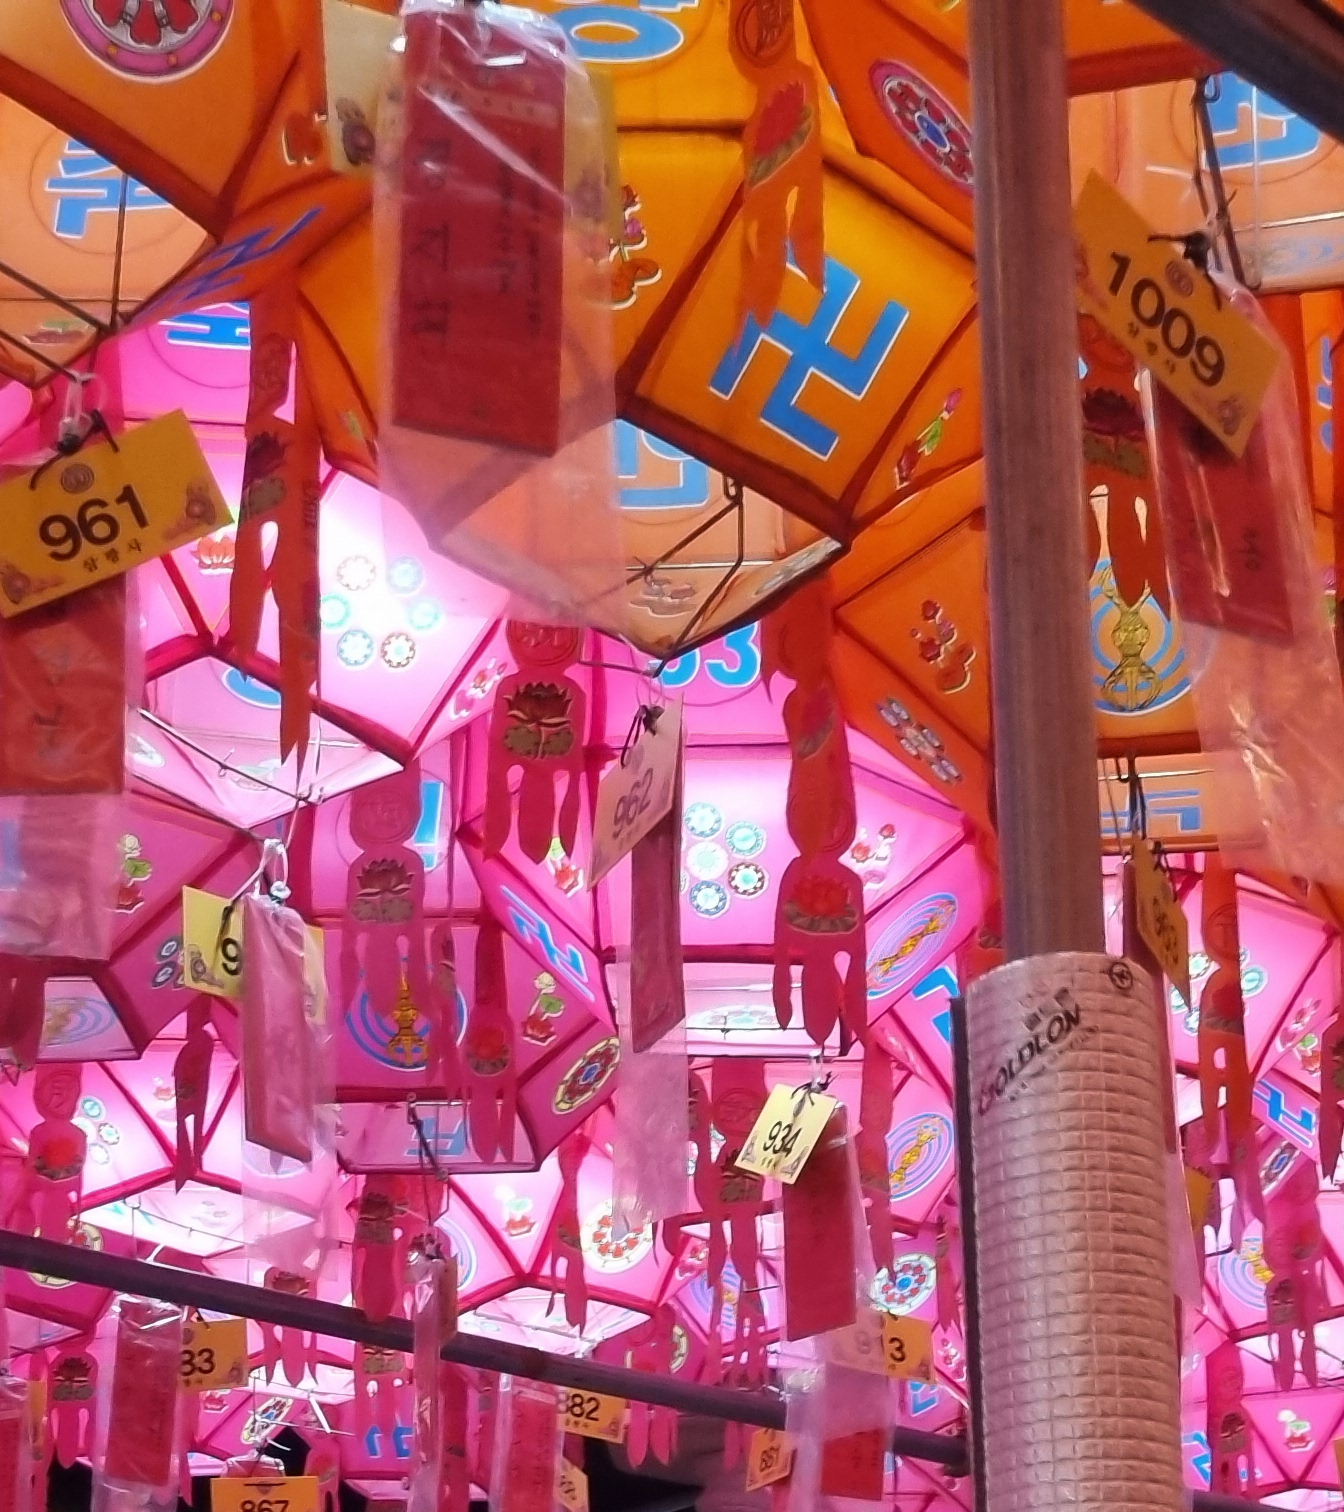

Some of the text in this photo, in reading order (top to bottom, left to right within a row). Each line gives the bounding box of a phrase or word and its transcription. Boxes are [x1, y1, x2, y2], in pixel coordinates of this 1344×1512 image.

[1110, 251, 1225, 387] 1009
[39, 484, 150, 562] 961
[613, 768, 653, 838] 962
[763, 1121, 802, 1158] 934
[179, 1348, 216, 1376] 83
